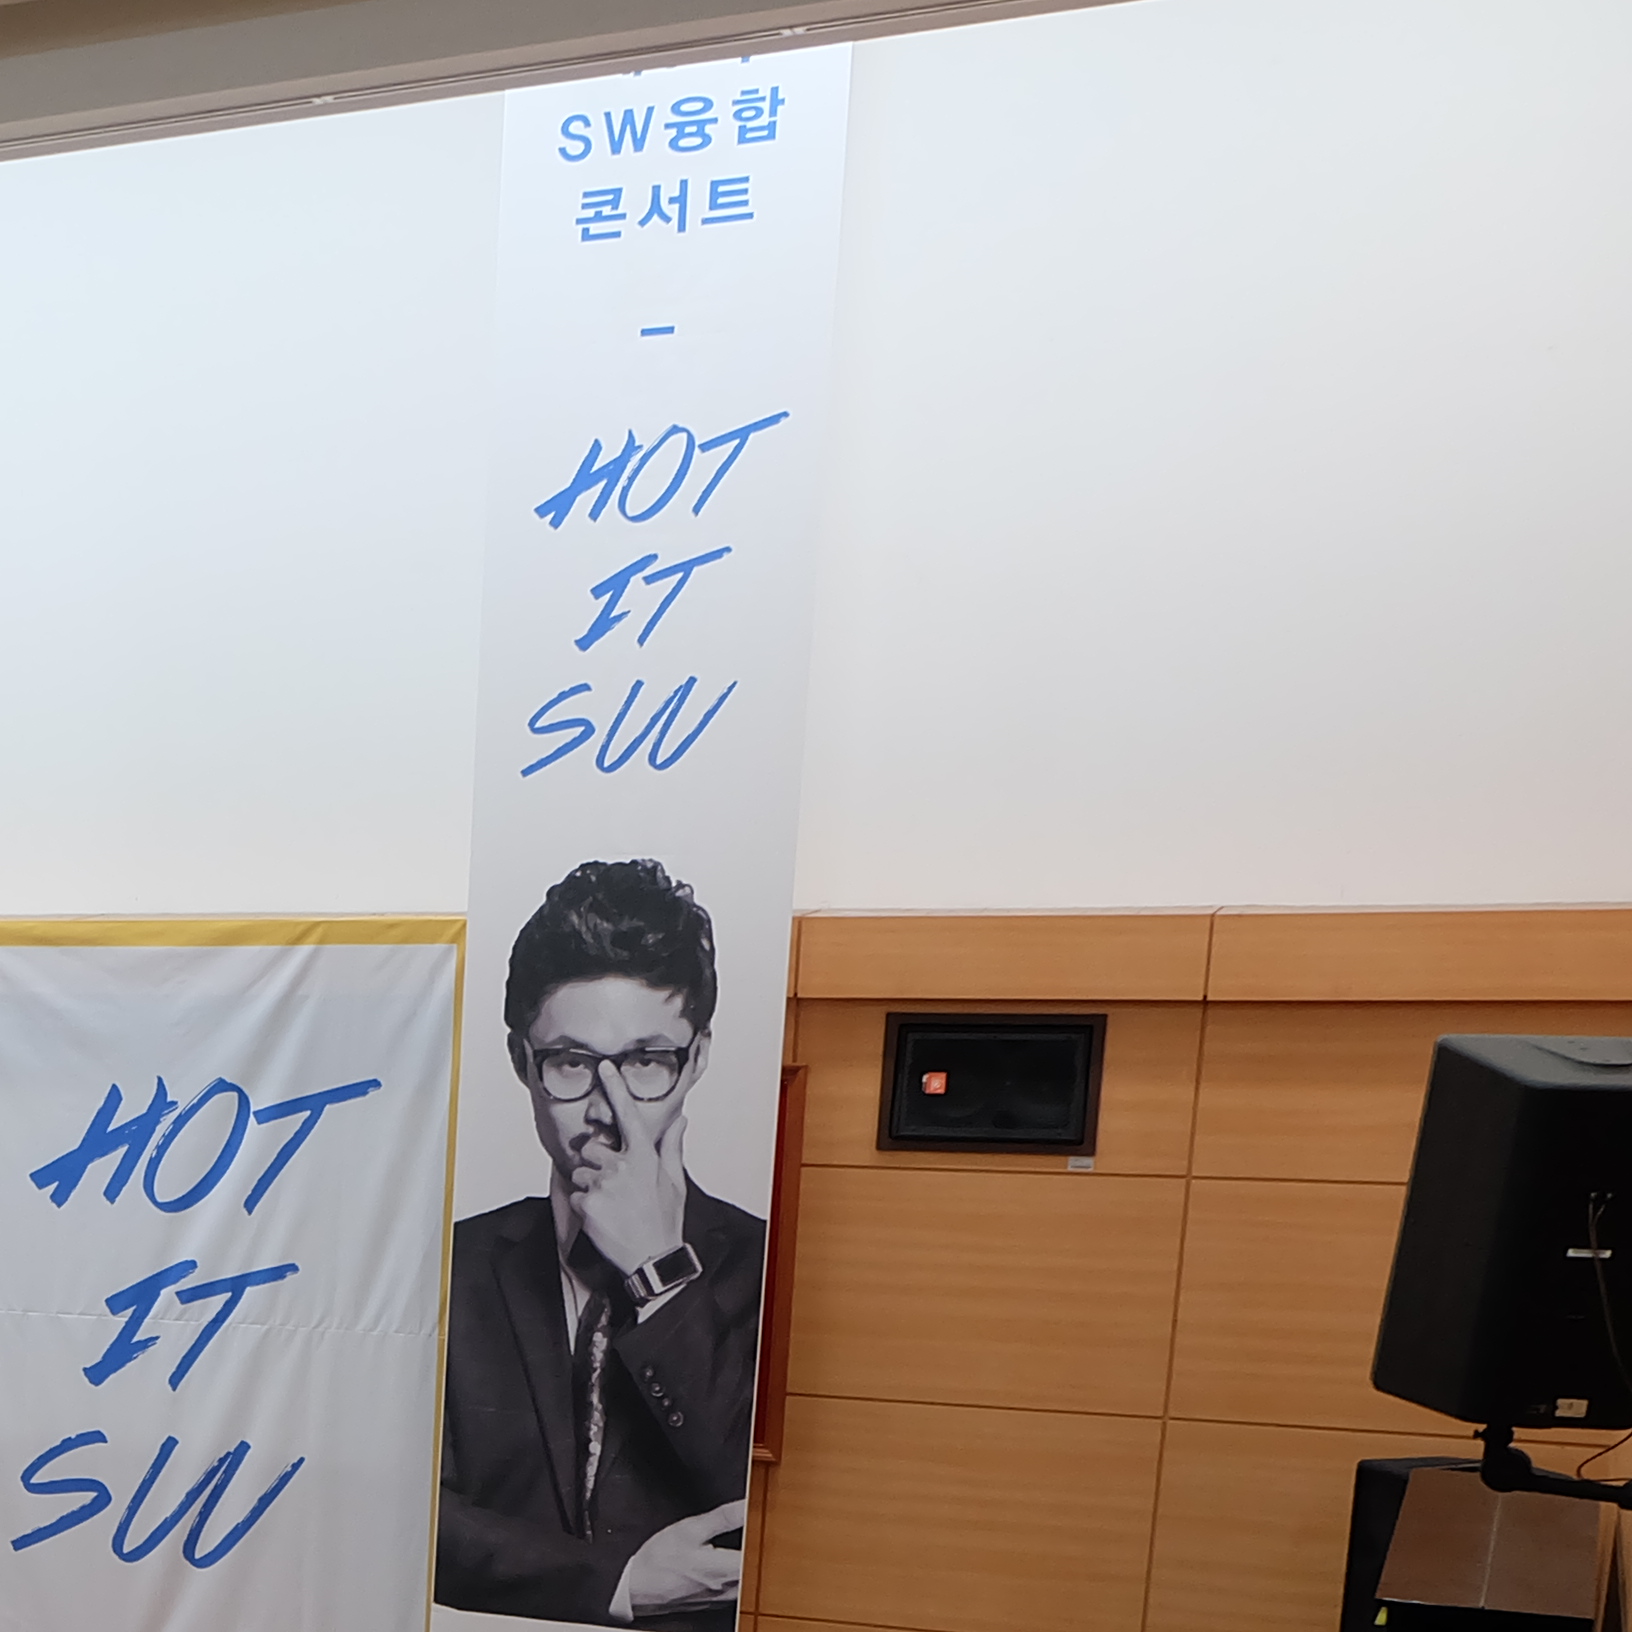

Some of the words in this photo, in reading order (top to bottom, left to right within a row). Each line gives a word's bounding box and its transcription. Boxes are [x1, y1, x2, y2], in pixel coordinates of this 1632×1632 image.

[557, 86, 786, 163] SW융합
[574, 174, 756, 243] 콘서트
[533, 409, 791, 531] HOT
[574, 546, 733, 652] IT
[520, 675, 739, 778] SW
[29, 1076, 382, 1215] HOT
[82, 1259, 299, 1392] IT
[11, 1429, 305, 1569] SW
